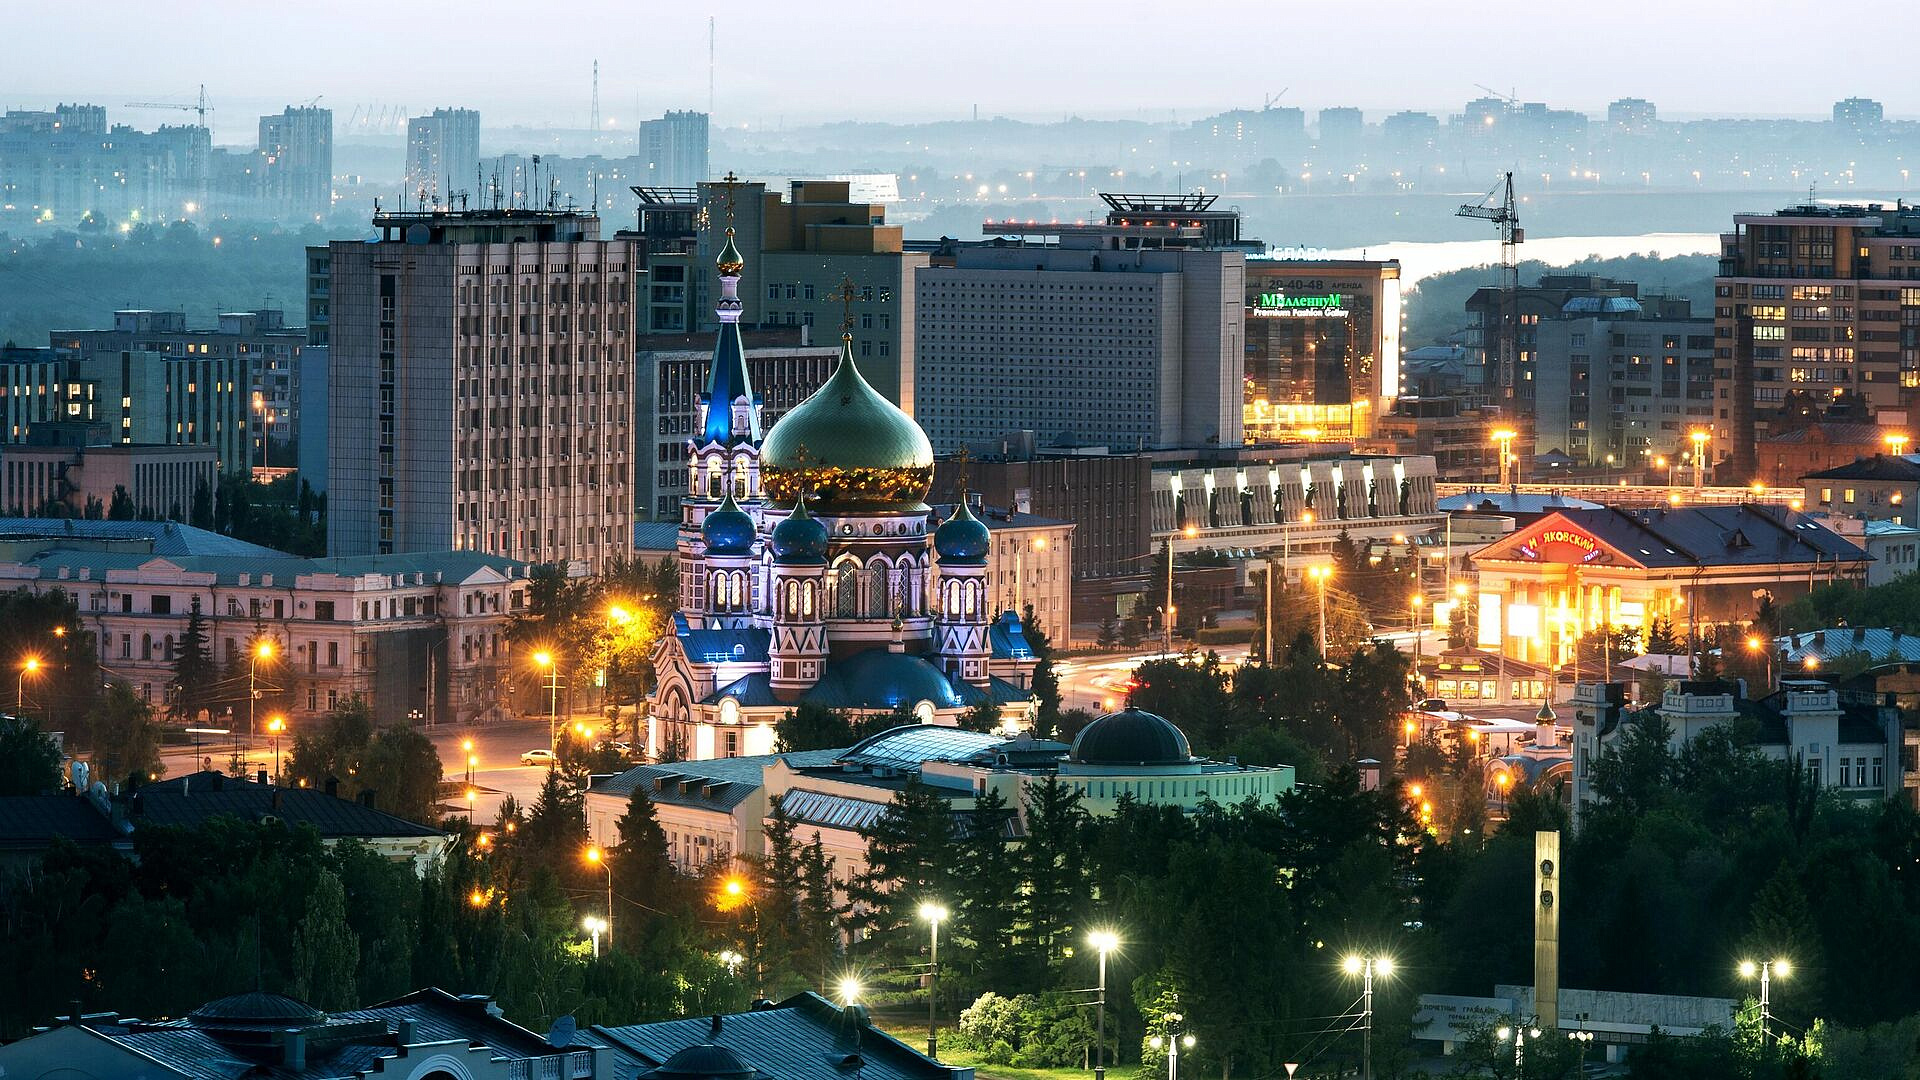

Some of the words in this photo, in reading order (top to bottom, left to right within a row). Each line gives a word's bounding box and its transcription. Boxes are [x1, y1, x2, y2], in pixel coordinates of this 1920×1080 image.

[1273, 248, 1330, 261] СЛАВА
[1293, 308, 1323, 316] Fashion
[1529, 532, 1594, 552] МЯКОВСКИЙ
